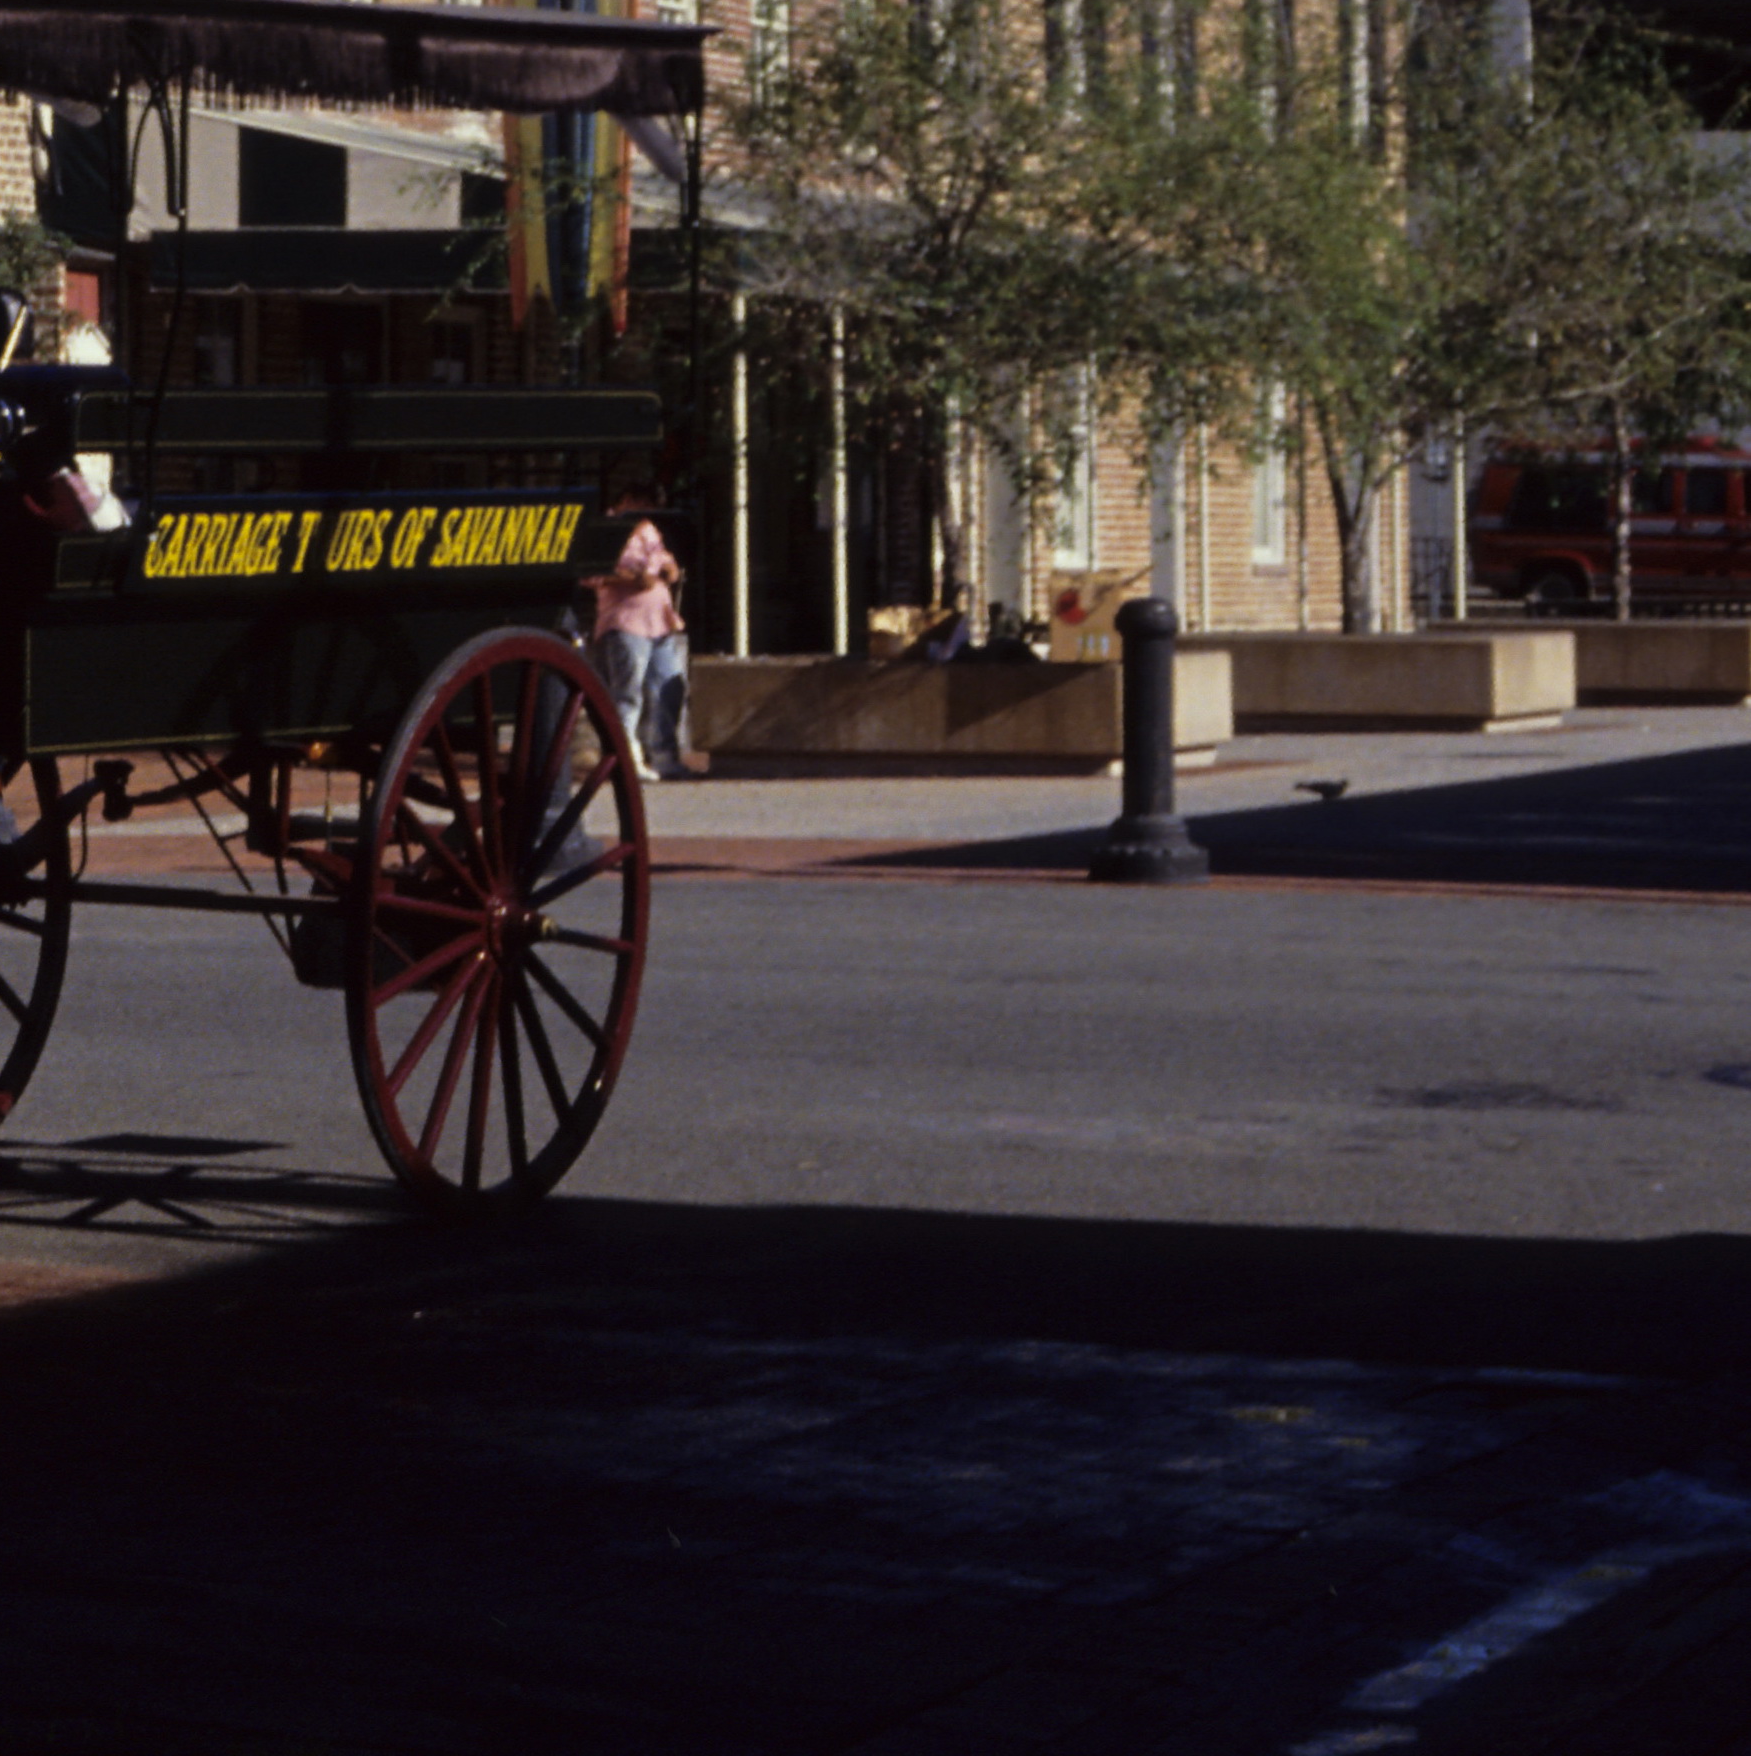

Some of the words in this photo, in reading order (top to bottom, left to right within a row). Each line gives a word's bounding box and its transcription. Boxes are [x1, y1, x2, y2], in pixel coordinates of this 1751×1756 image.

[143, 510, 293, 578] CARRIAGE
[291, 508, 393, 573] TURS
[390, 507, 438, 569] OF
[429, 504, 584, 568] SAVANNAH
